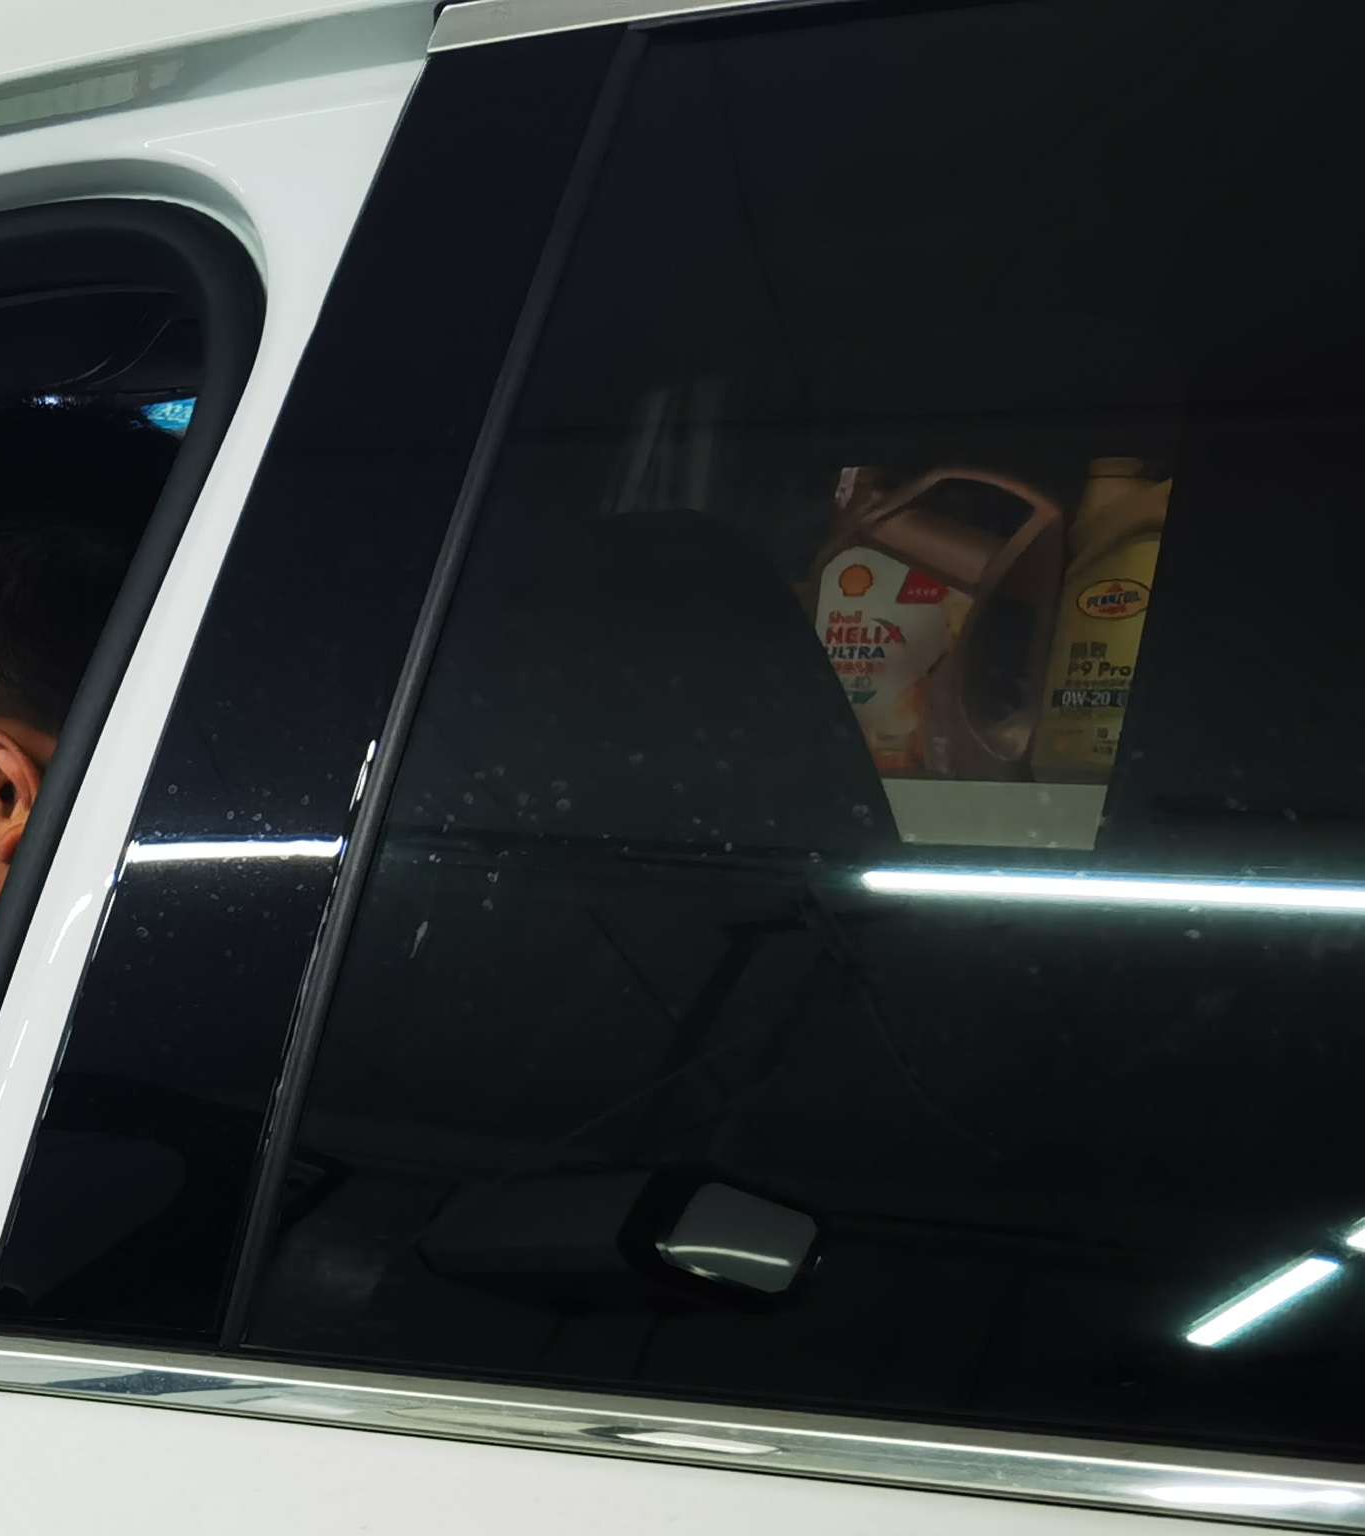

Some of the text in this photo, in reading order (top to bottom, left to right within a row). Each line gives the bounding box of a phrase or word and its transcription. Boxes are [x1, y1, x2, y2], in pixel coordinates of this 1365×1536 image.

[825, 620, 905, 645] HELIX
[1098, 662, 1133, 677] Pro
[1062, 690, 1111, 706] 0W-20
